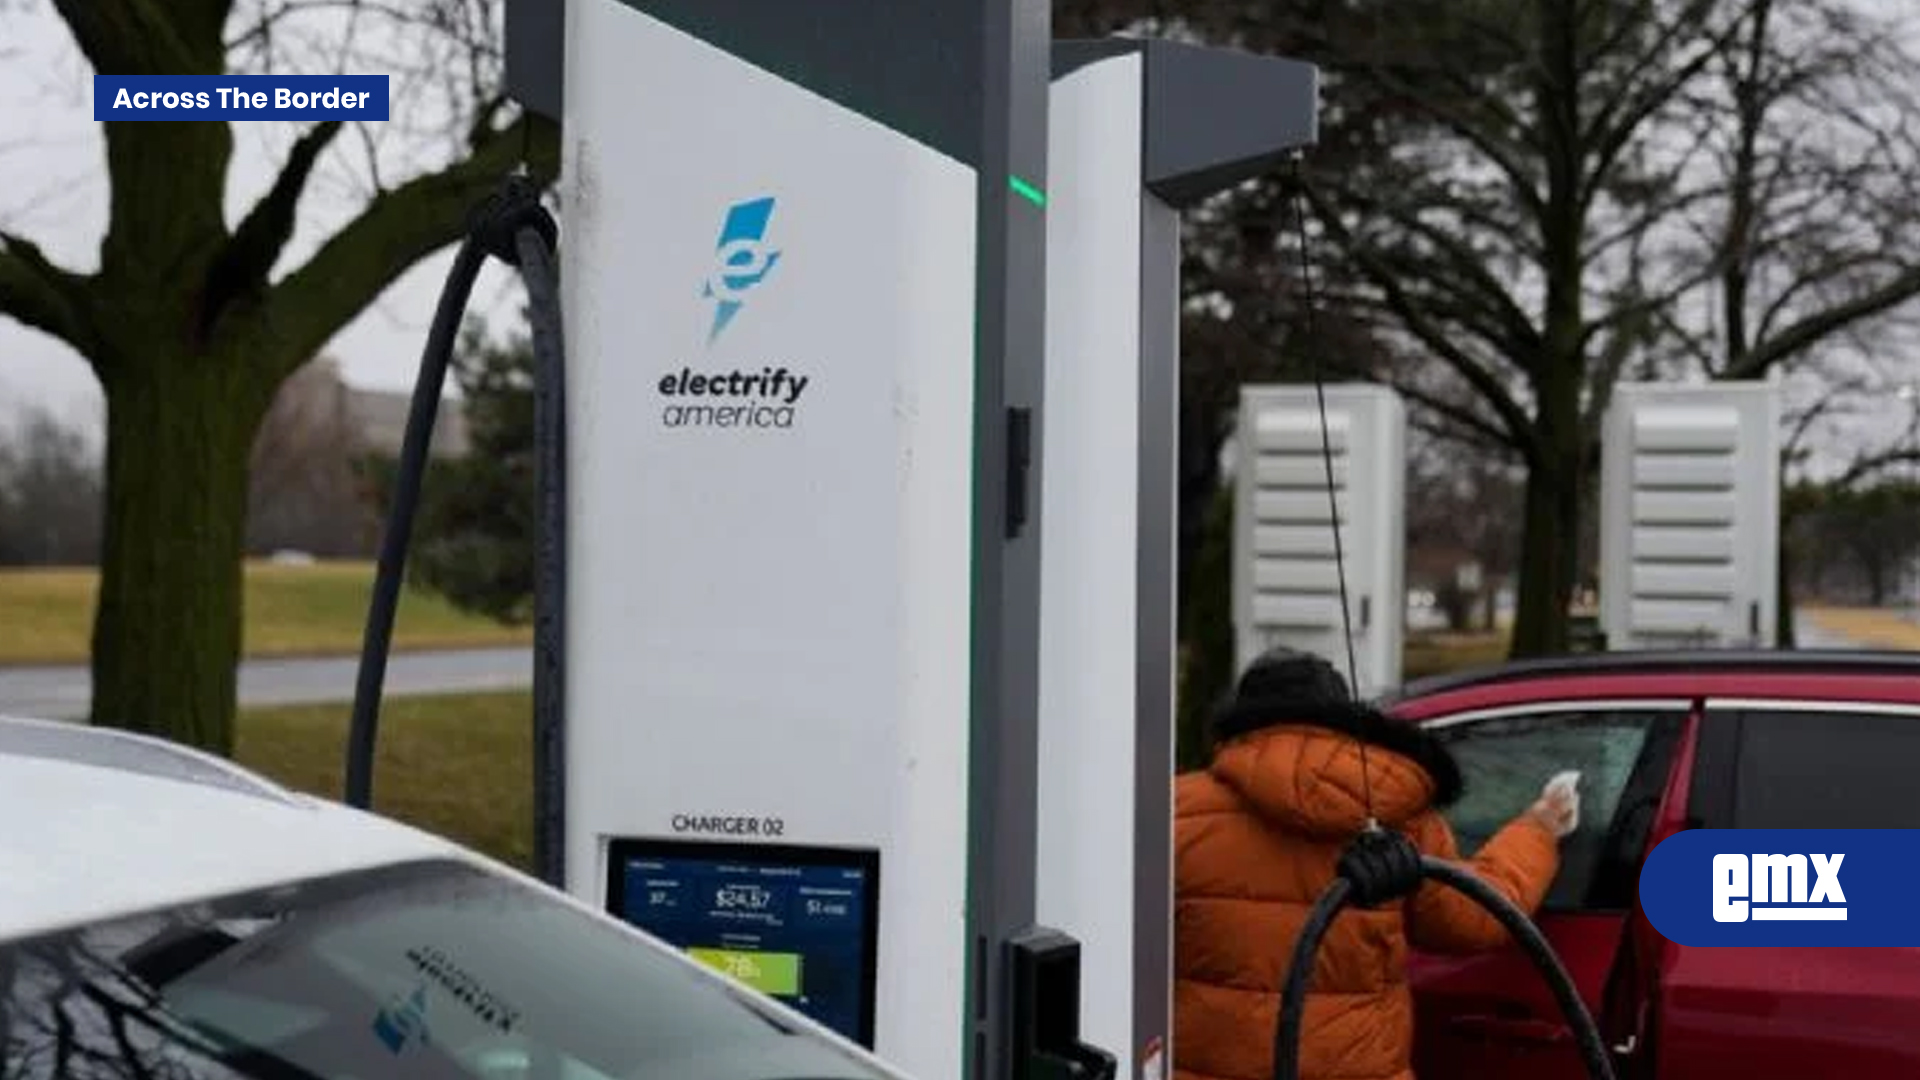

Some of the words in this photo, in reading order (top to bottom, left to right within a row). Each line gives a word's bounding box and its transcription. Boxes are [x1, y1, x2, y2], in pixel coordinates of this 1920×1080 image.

[658, 366, 809, 404] electrify
[662, 401, 795, 428] america
[671, 814, 759, 835] CHARGER
[763, 818, 784, 836] 02
